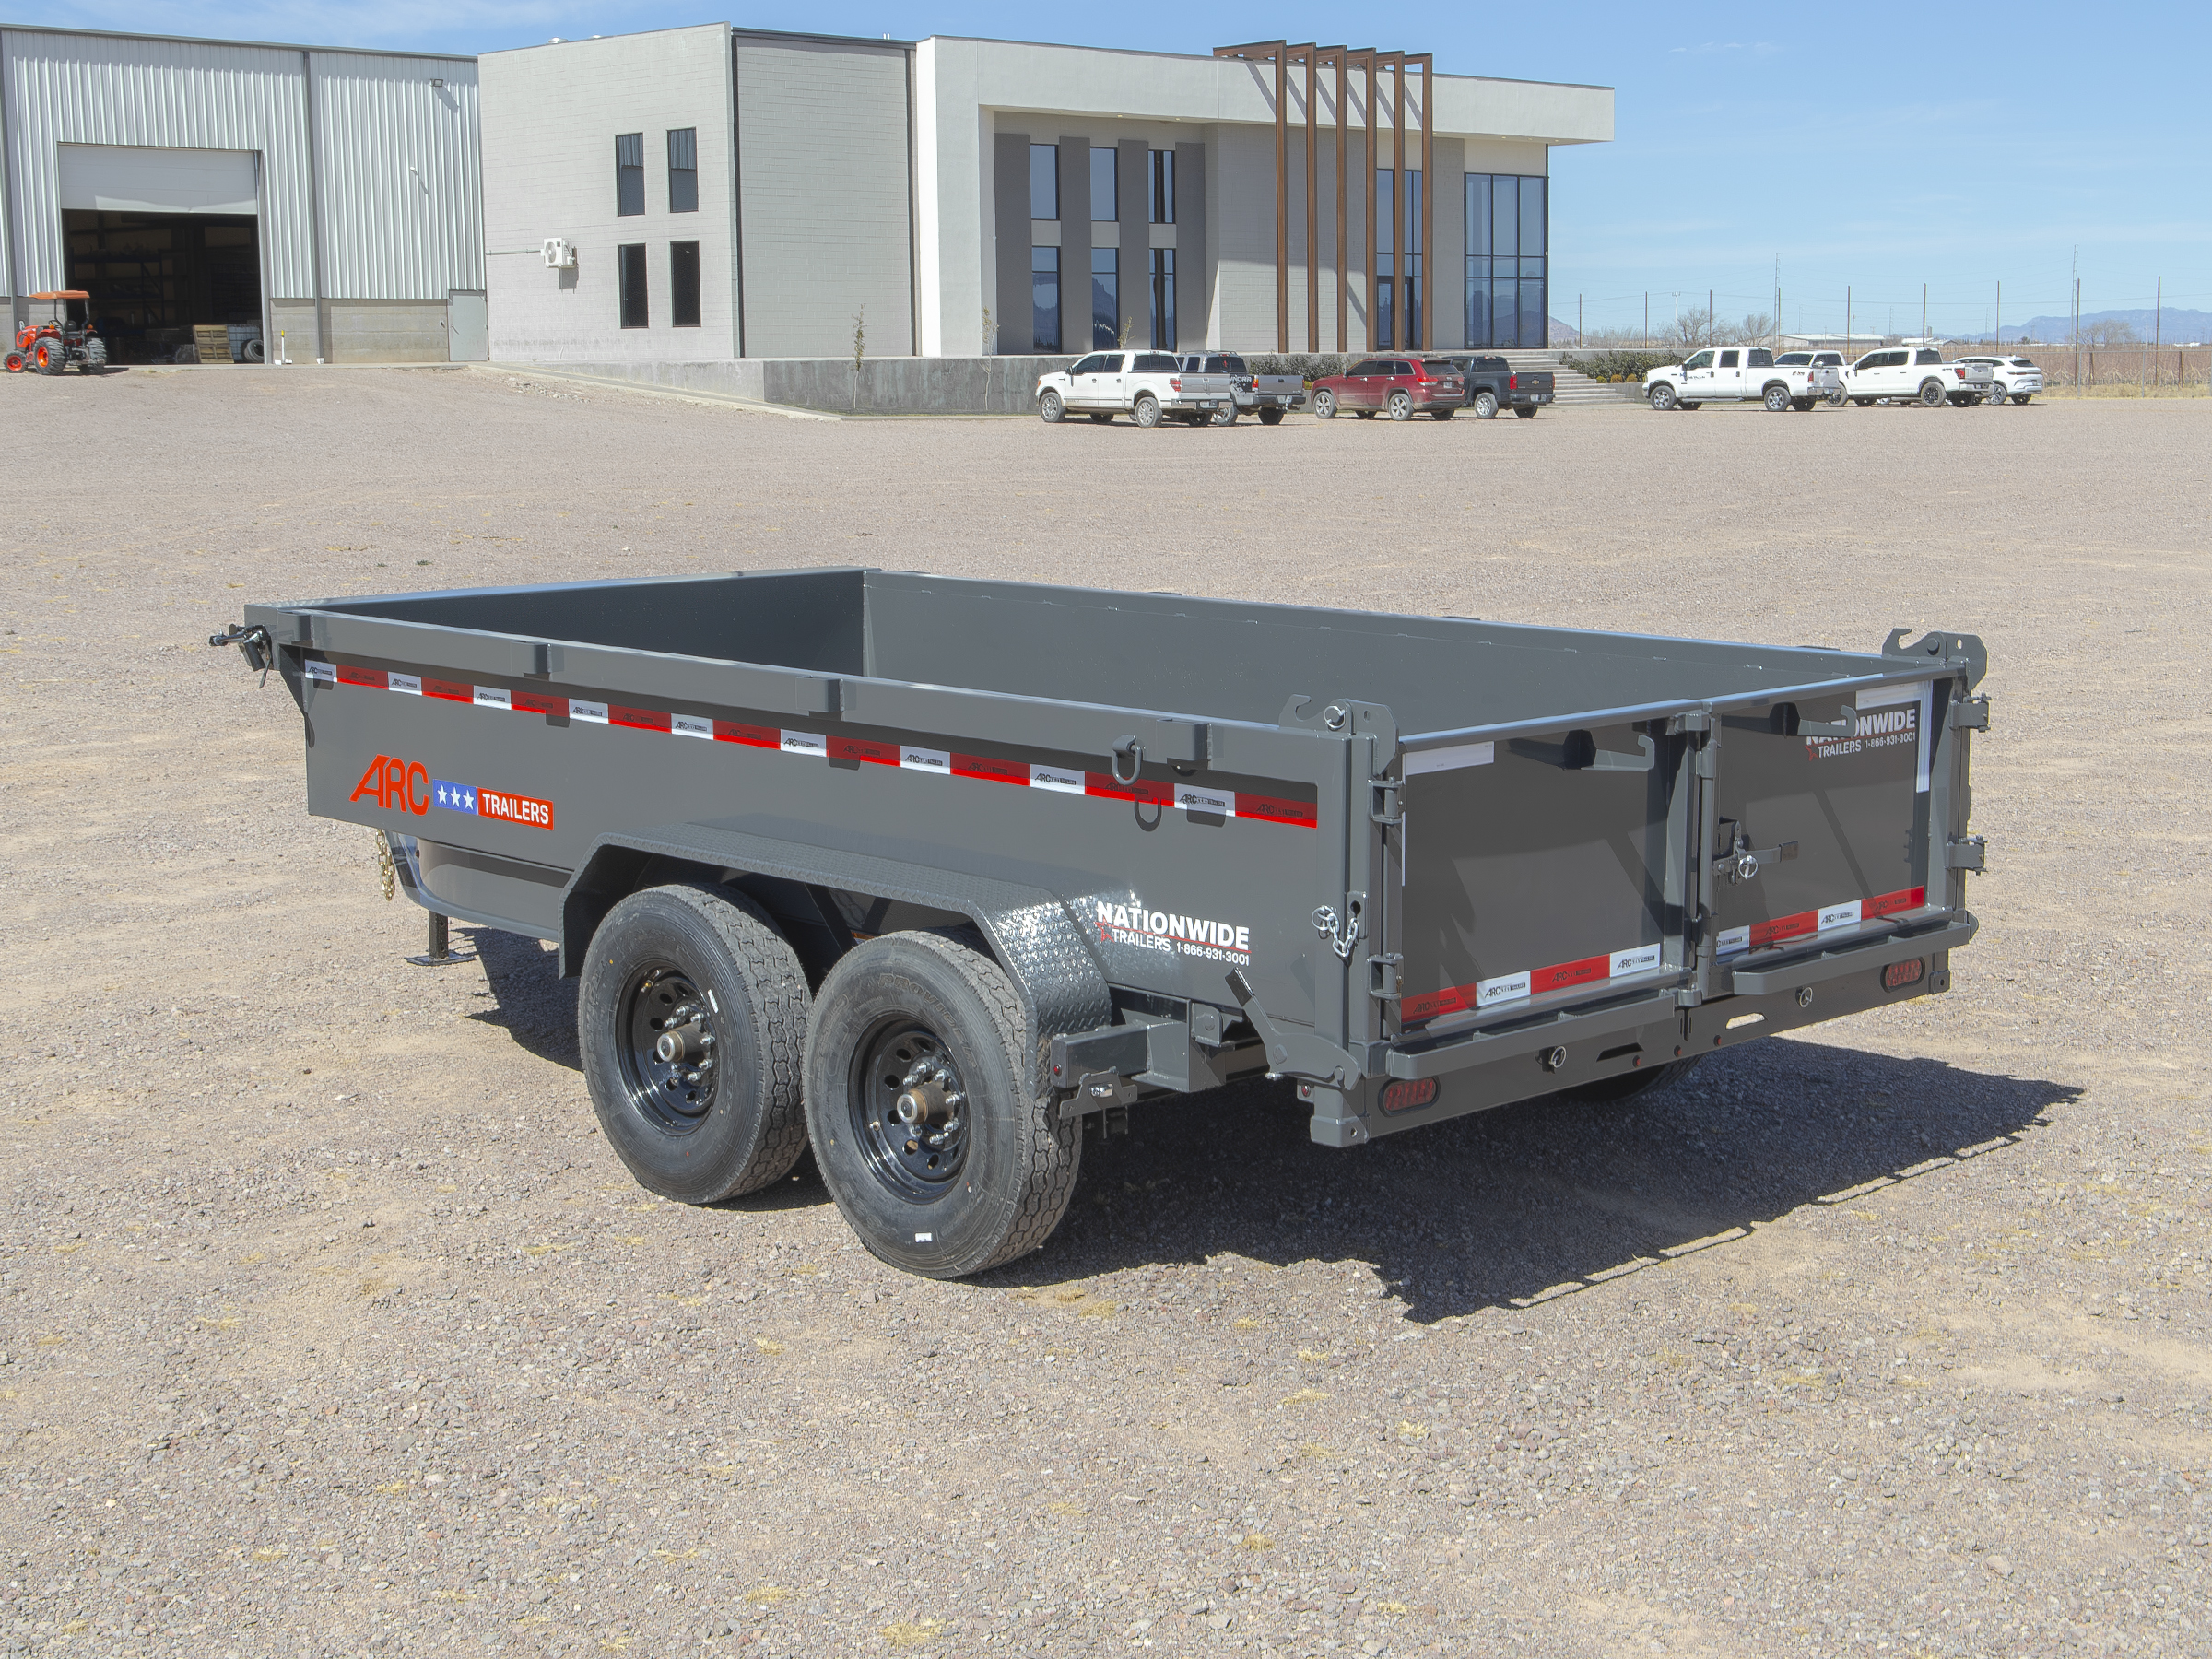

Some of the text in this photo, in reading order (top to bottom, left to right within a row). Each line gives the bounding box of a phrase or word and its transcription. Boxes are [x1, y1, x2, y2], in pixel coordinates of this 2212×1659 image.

[676, 721, 688, 730] ARC
[783, 738, 798, 747] ARC
[1818, 739, 1862, 759] TRAILERS
[905, 754, 920, 764] ARC
[1034, 772, 1051, 782] ARC
[349, 754, 548, 825] ARC TRAILERS
[1180, 794, 1197, 805] ARC
[1097, 901, 1250, 950] NATIONWIDE
[1112, 929, 1250, 966] TRAILERS 1-866-931-3001
[1617, 958, 1631, 970] ARC
[1485, 986, 1500, 998] ARC
